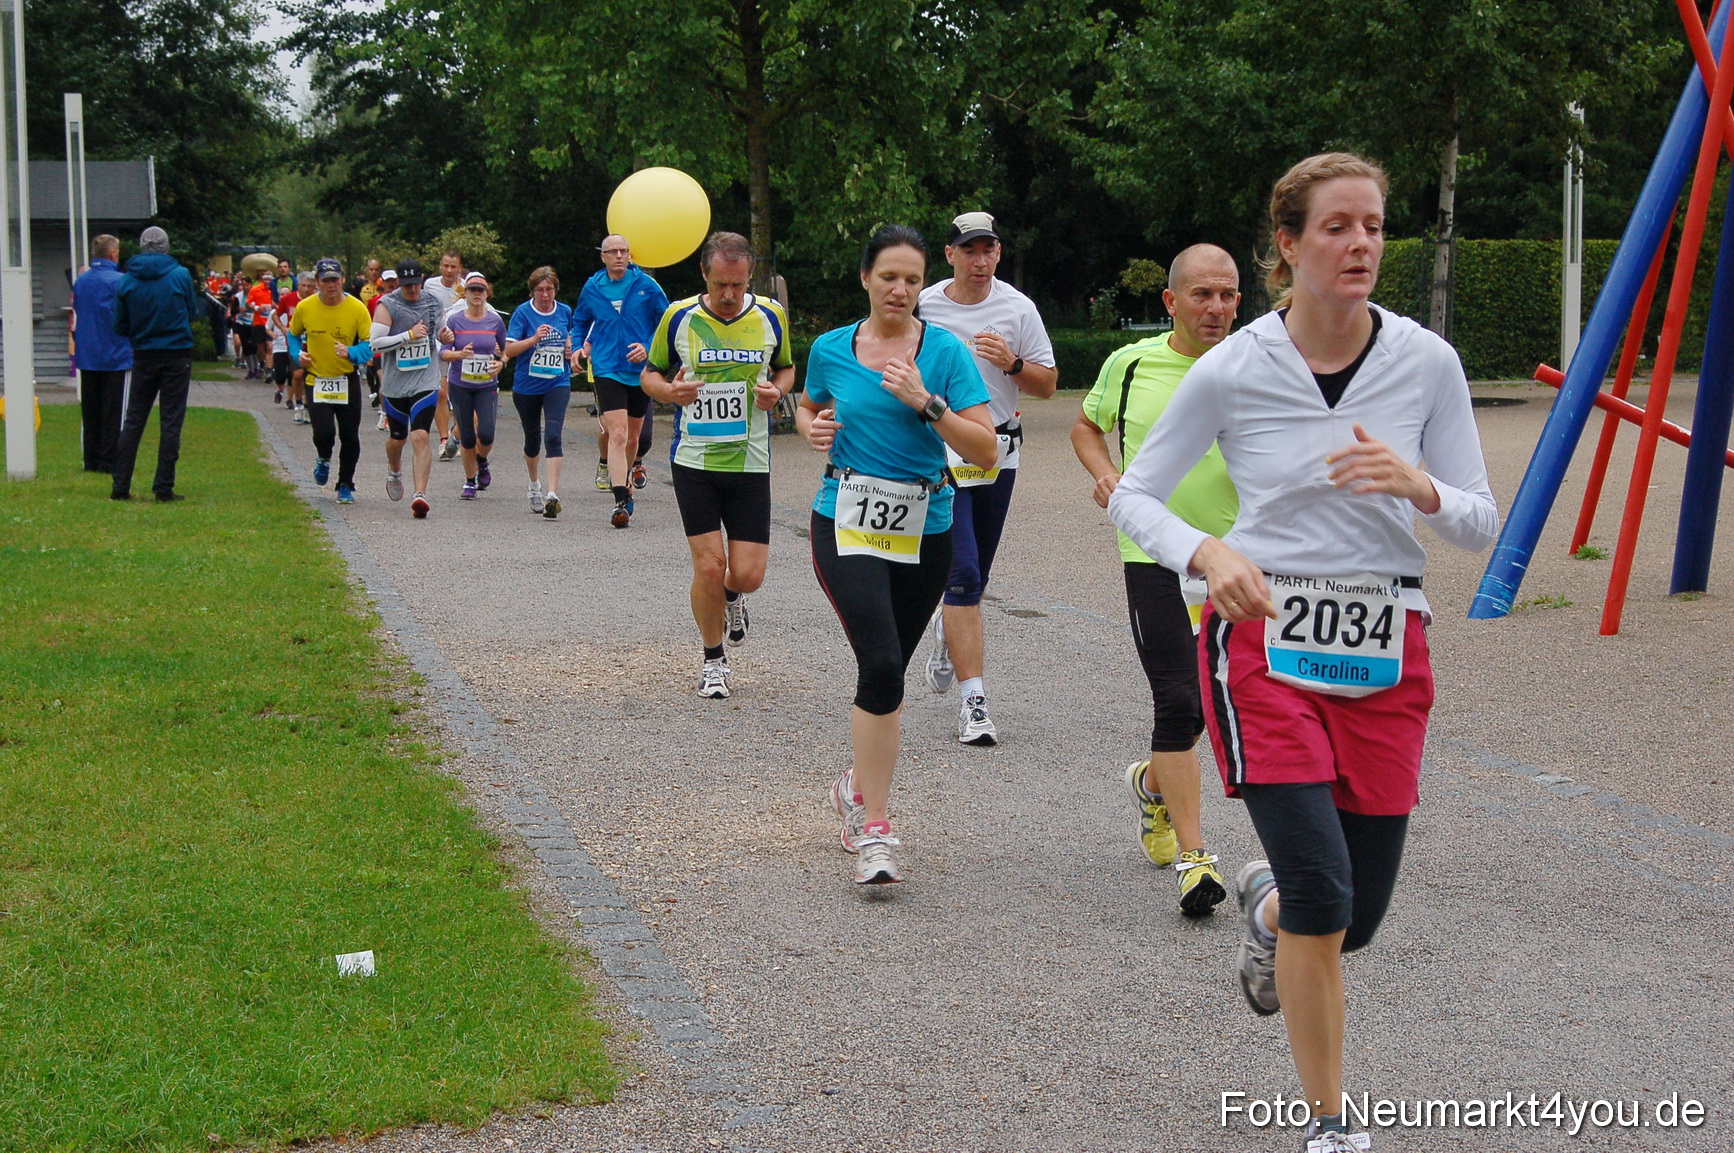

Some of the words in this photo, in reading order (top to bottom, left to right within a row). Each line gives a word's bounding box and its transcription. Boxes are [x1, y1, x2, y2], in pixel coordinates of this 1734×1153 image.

[400, 344, 427, 359] 2177
[534, 352, 562, 367] 2102
[699, 349, 764, 364] BOCK
[321, 380, 341, 392] 231
[705, 388, 736, 396] Neumarkt
[693, 397, 742, 420] 3103
[840, 482, 870, 494] PARTL
[872, 486, 914, 501] Neumarkt
[856, 497, 909, 532] 132
[1274, 575, 1321, 590] PARTL
[1325, 579, 1388, 596] Neumarkt
[1280, 595, 1394, 650] 2034
[1297, 657, 1370, 681] Carolina
